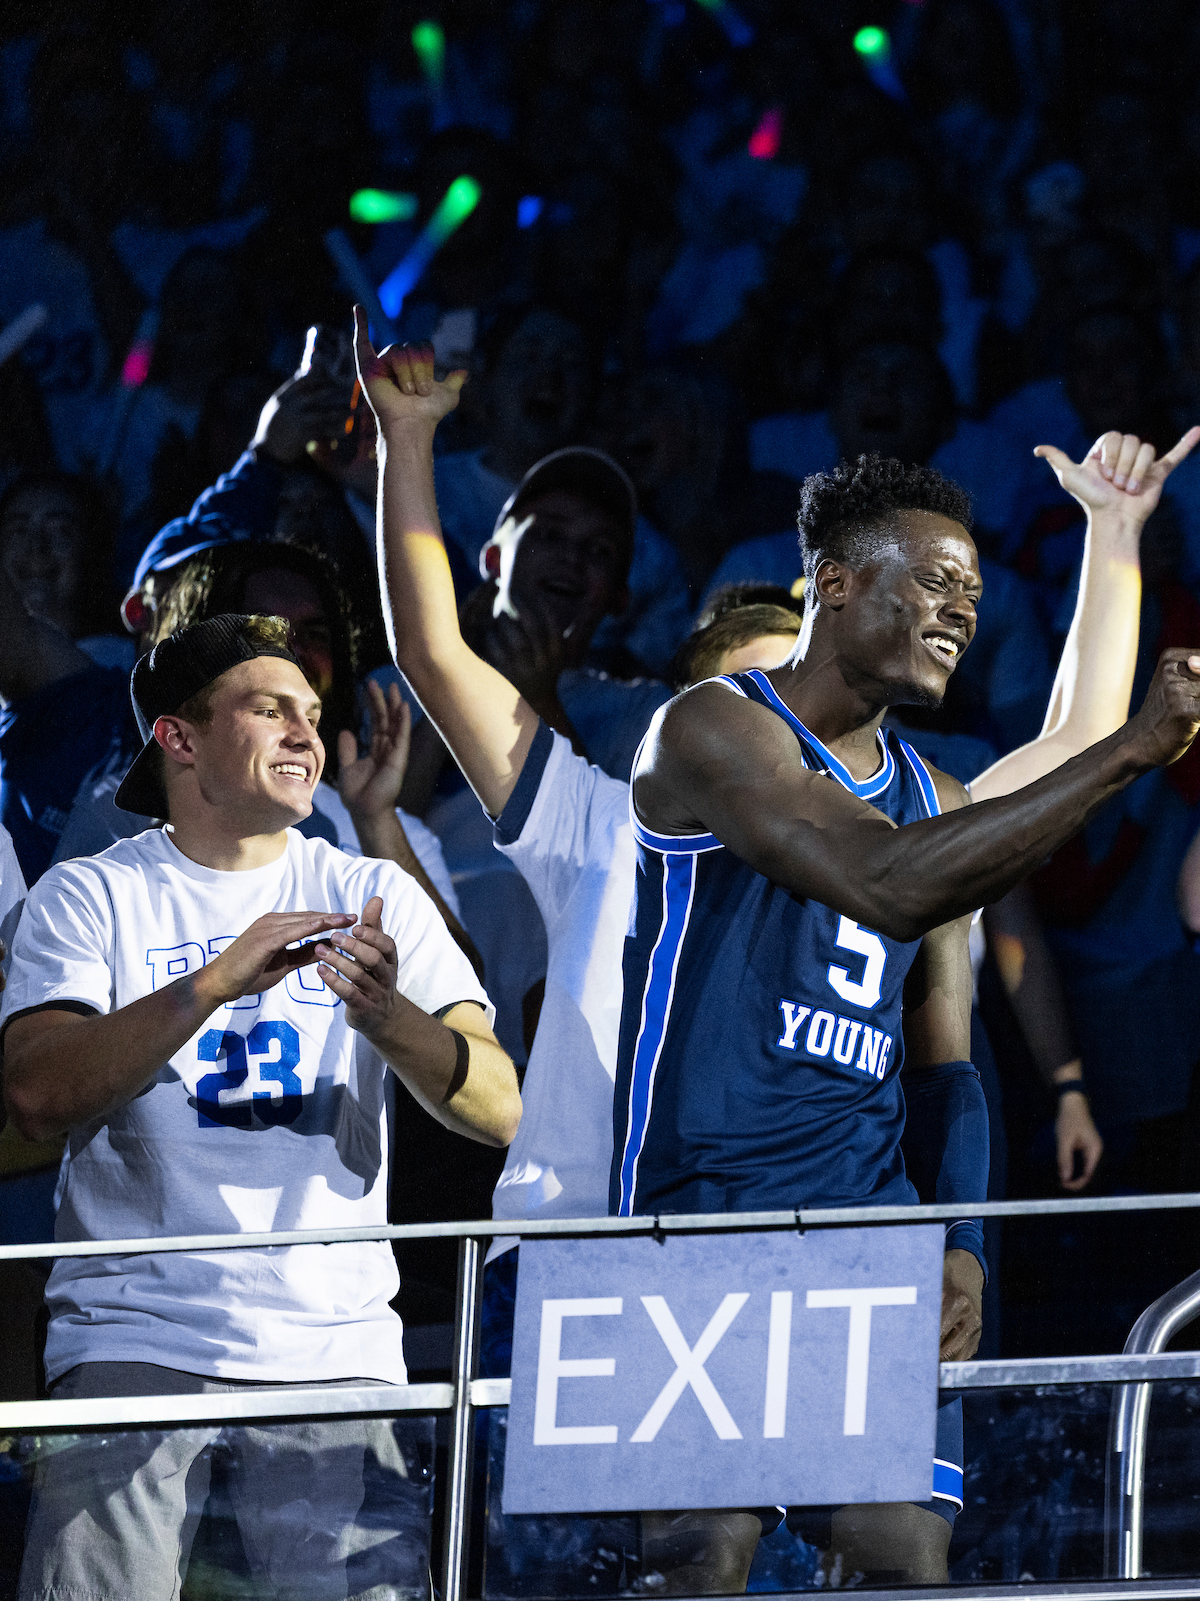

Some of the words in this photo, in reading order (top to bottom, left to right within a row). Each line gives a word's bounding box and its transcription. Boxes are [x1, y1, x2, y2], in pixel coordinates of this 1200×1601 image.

[826, 914, 889, 1010] 5
[196, 1020, 303, 1128] 23
[776, 998, 893, 1081] YOUNG
[533, 1286, 918, 1446] EXIT
